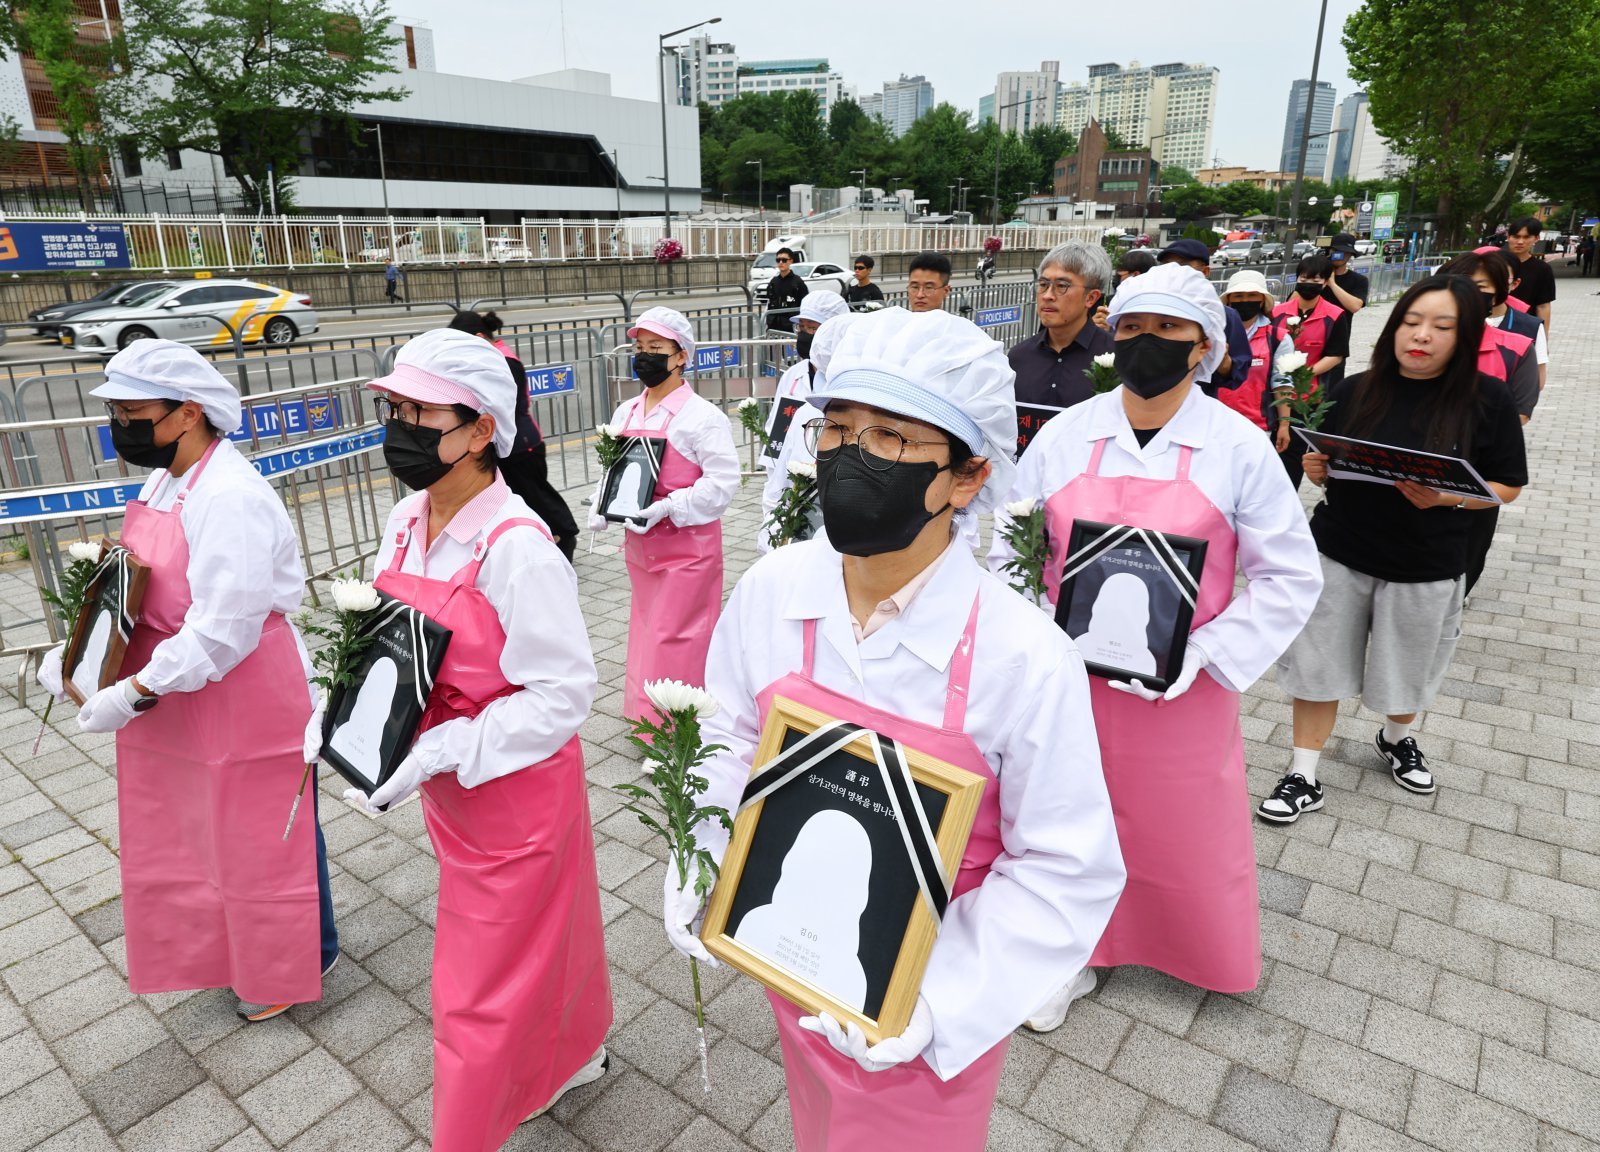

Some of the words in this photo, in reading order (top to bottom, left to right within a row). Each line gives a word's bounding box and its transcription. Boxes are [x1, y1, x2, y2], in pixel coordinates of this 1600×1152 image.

[985, 312, 1002, 322] POLICE
[1003, 310, 1012, 320] LINE
[698, 351, 720, 366] LINE
[528, 374, 549, 391] INE
[252, 408, 299, 432] LINE
[253, 448, 314, 475] OLICE
[328, 435, 365, 455] LINE
[38, 488, 126, 512] LINE
[808, 773, 847, 798] 삼가고인의
[847, 791, 871, 809] 명복을
